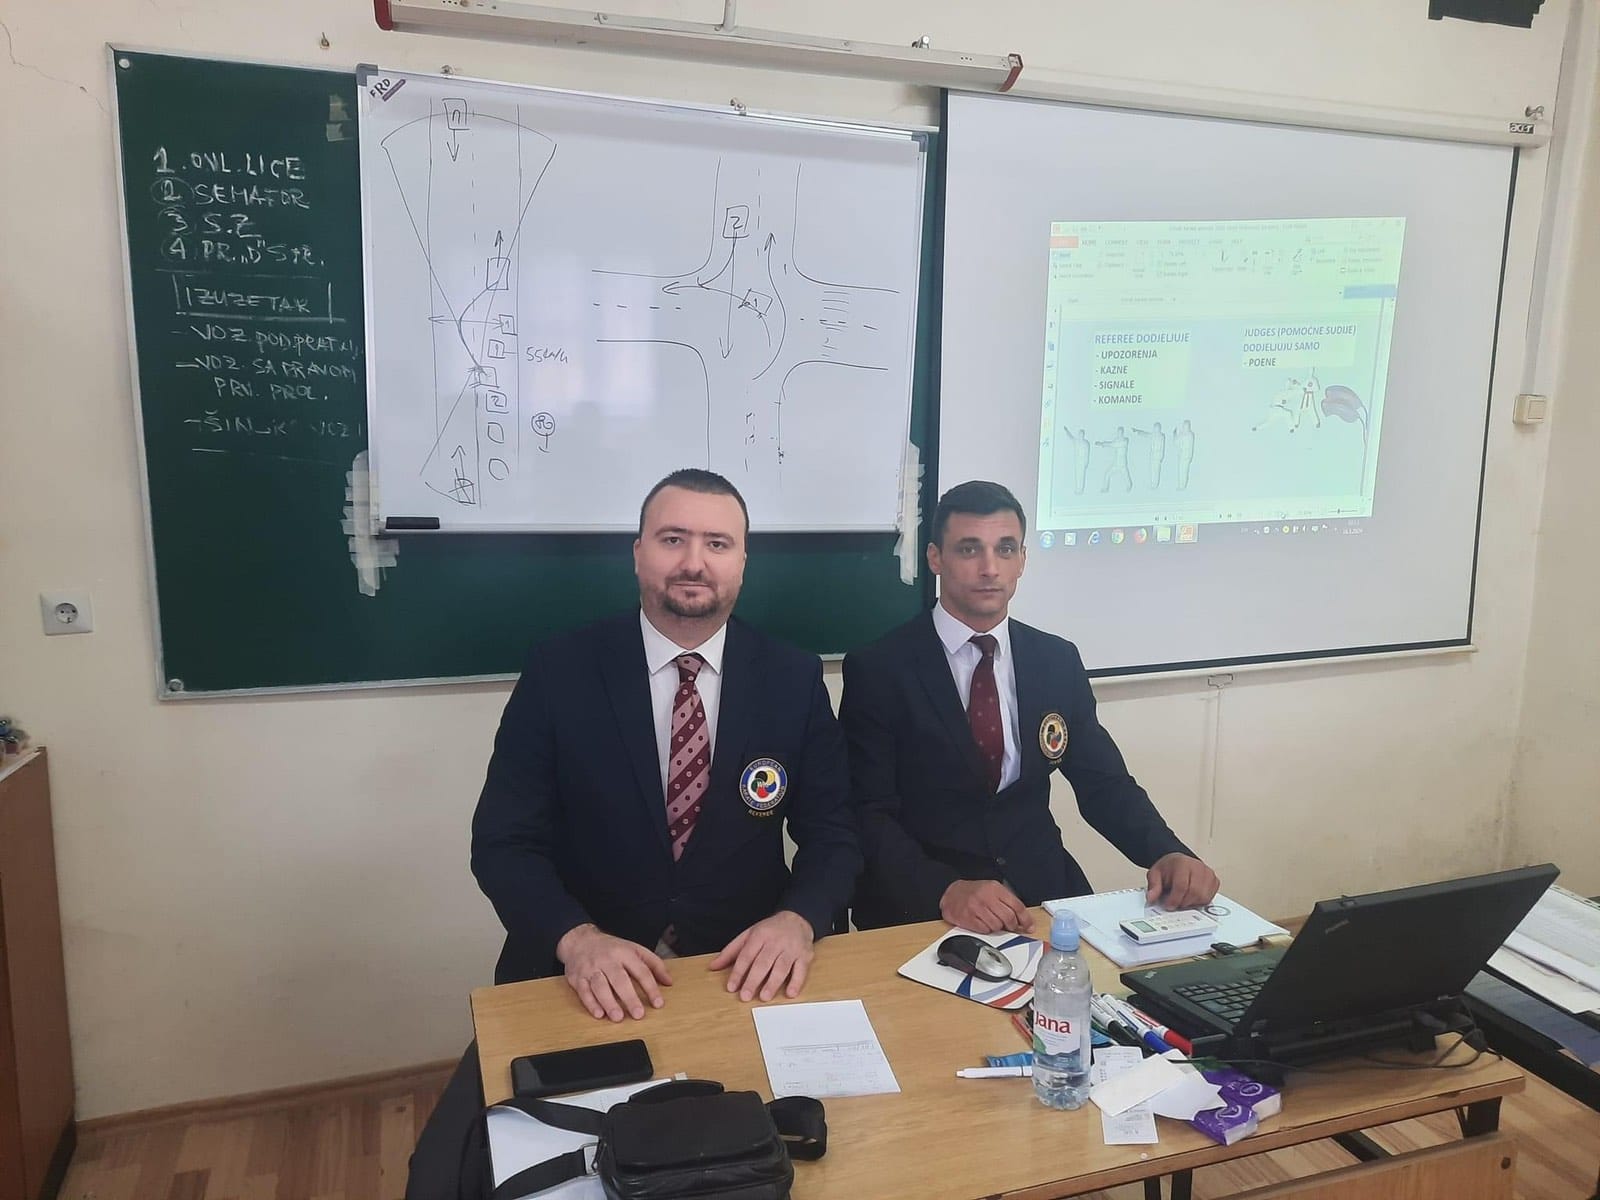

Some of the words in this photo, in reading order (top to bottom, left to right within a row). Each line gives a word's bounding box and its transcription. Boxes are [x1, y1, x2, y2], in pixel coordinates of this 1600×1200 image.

[191, 323, 247, 342] VOZ
[1245, 328, 1277, 337] JUDGES
[1095, 334, 1134, 344] REFEREE
[1295, 341, 1321, 351] SAMO
[1101, 349, 1158, 360] UPOZORENJA
[1248, 357, 1276, 367] POENE
[1100, 365, 1128, 375] KAZNE
[1099, 380, 1135, 390] SIGNALE
[1098, 395, 1143, 405] KOMANDE
